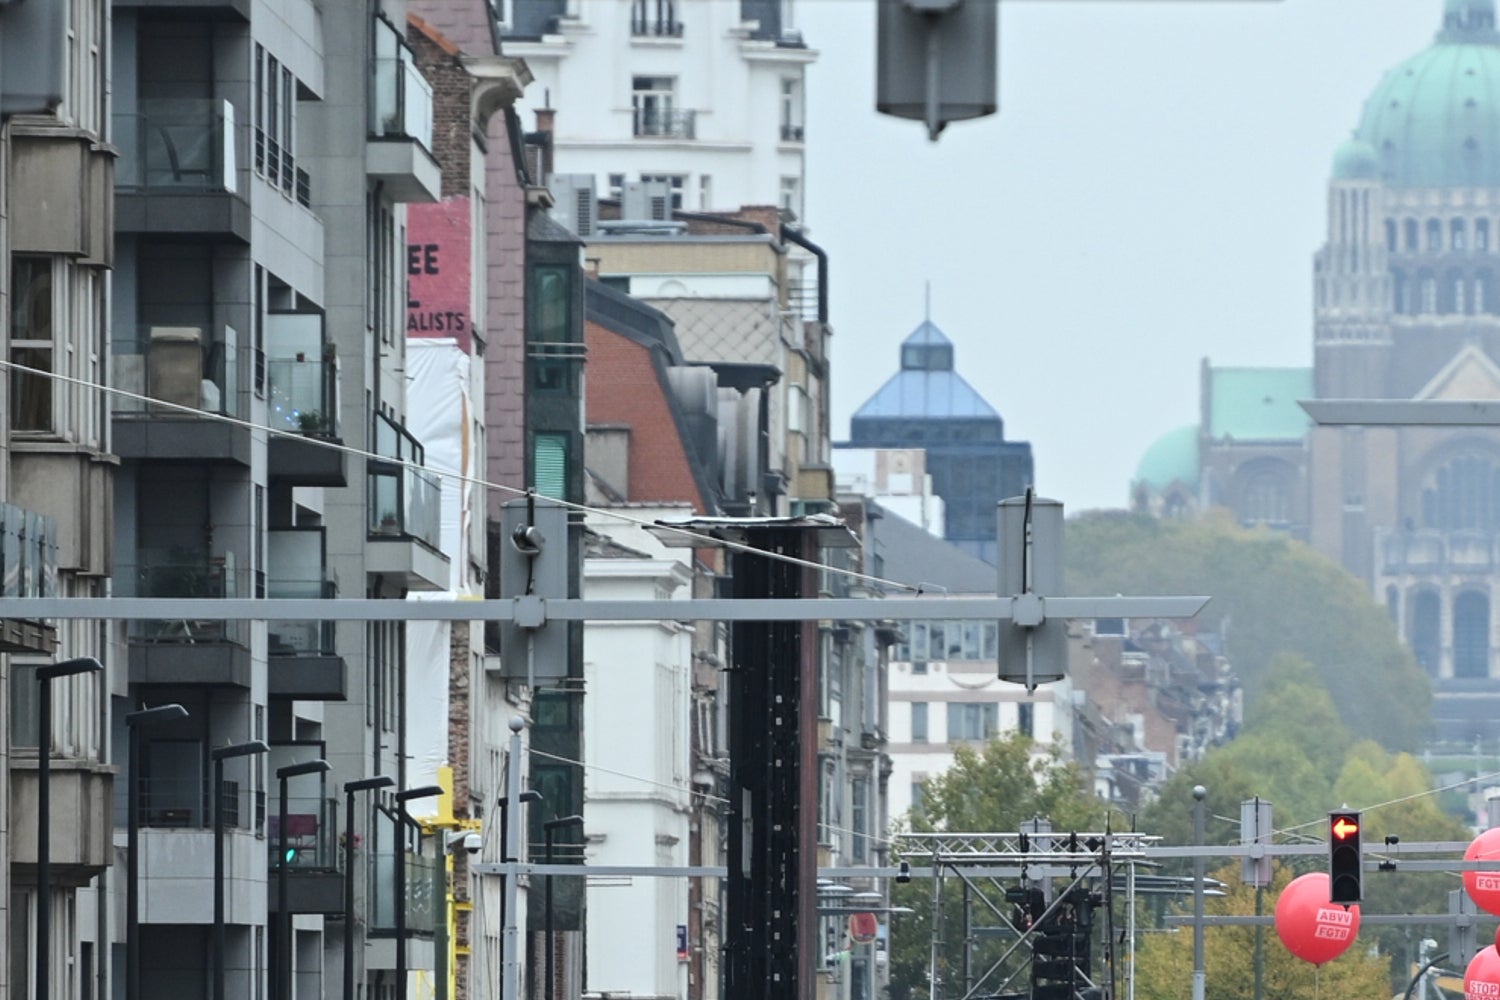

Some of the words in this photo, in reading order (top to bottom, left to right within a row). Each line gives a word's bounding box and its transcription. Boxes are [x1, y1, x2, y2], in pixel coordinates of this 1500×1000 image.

[1319, 910, 1350, 924] ABVV
[1317, 926, 1347, 939] FGTB
[1469, 982, 1498, 995] STOP
